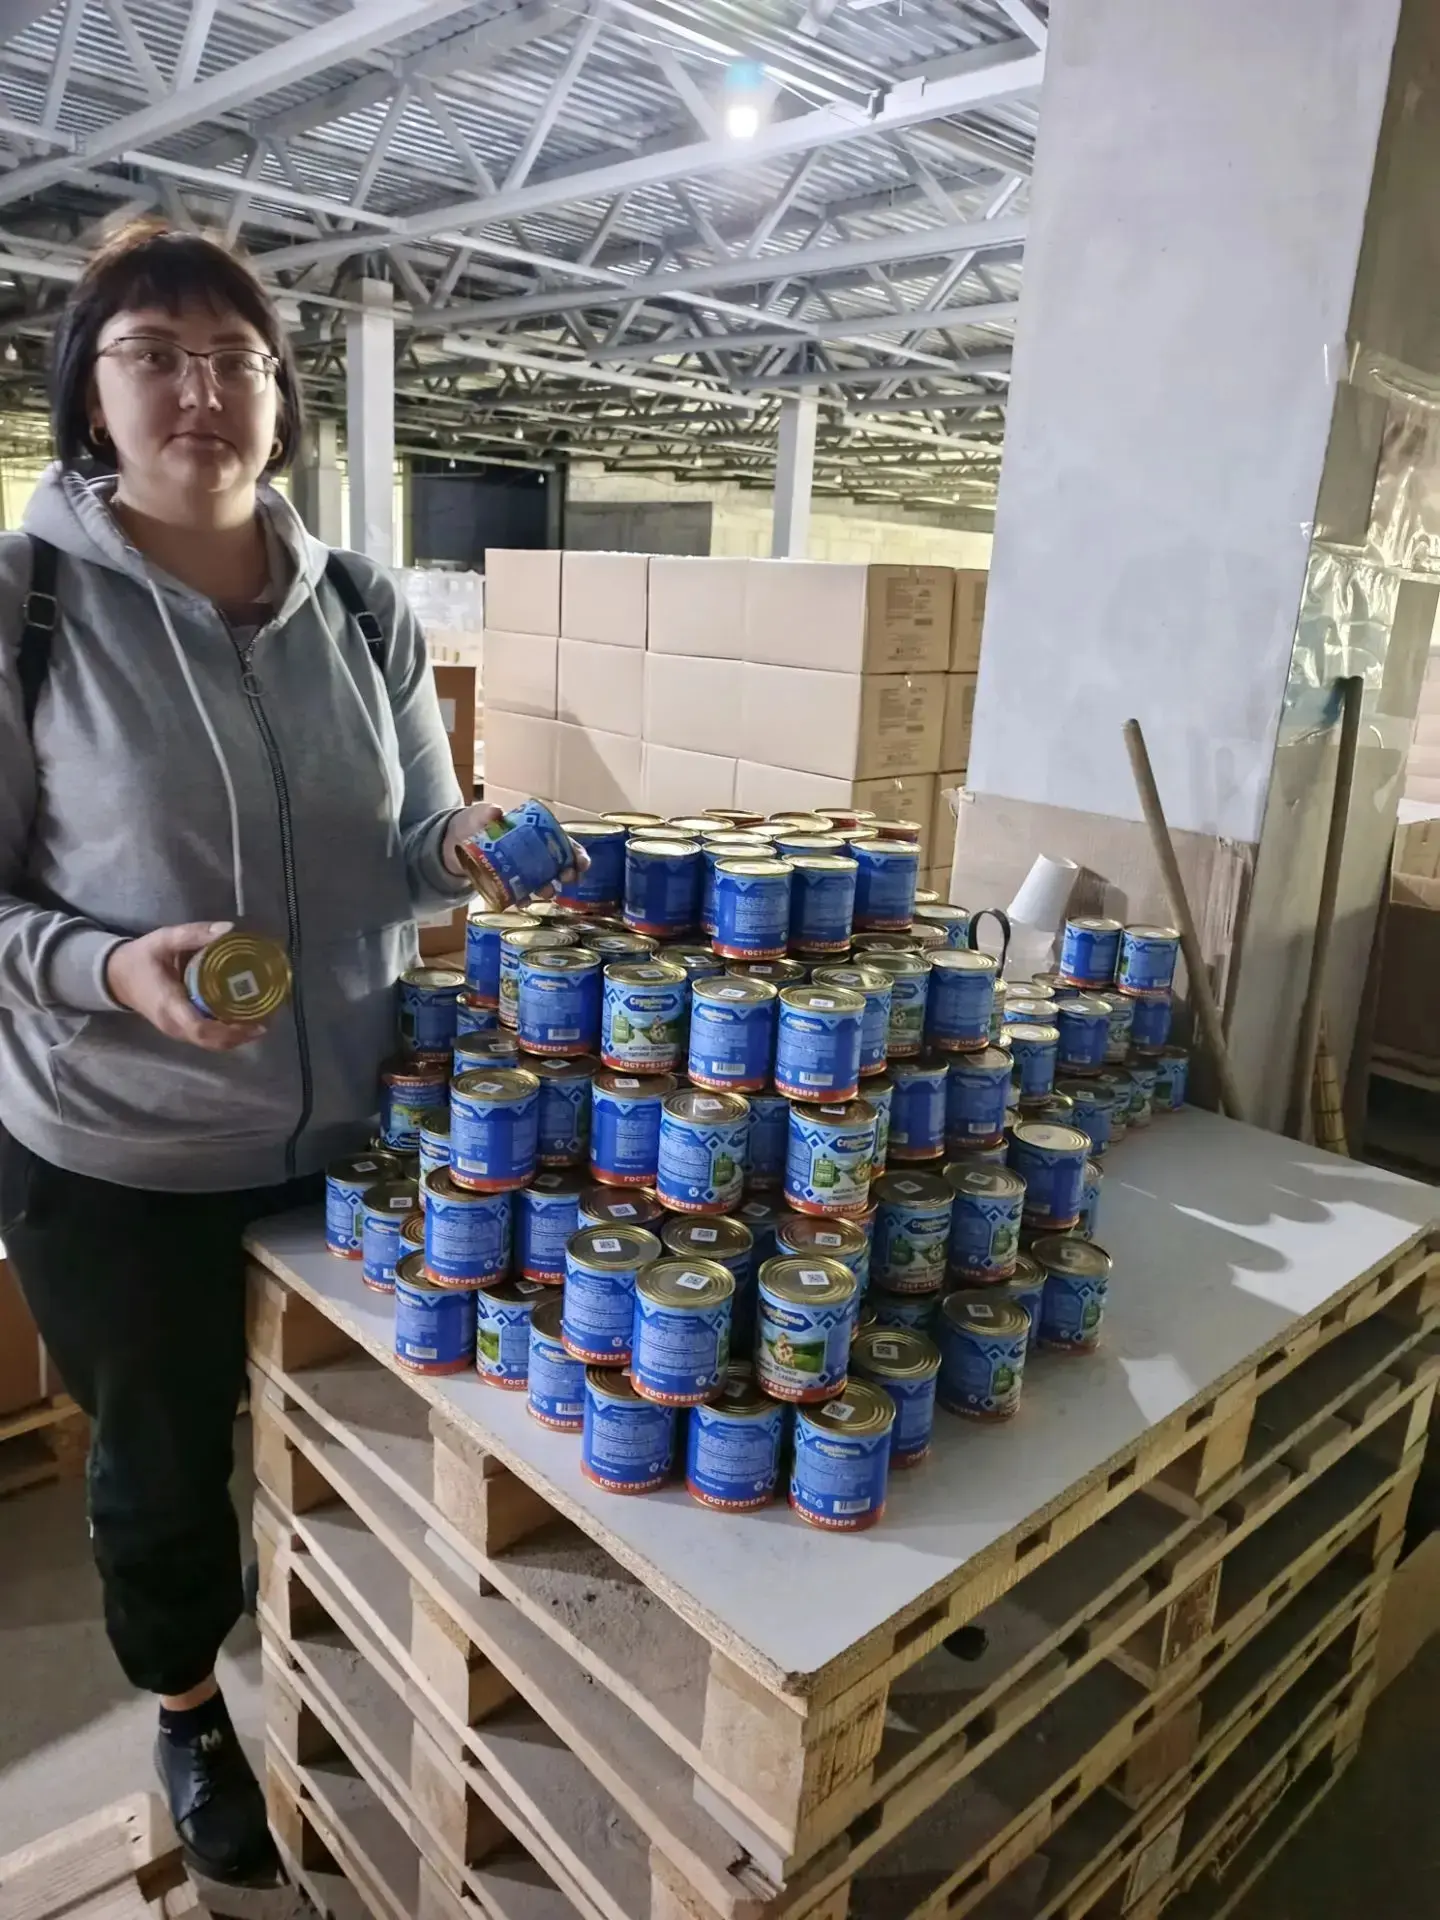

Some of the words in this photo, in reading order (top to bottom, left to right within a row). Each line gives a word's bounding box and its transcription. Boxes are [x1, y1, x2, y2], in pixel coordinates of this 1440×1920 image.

[539, 1271, 562, 1280] ГОСТ
[502, 1379, 526, 1387] ГОСТ
[644, 1387, 668, 1400] ГОСТ
[599, 1478, 622, 1489] ГОСТ
[703, 1494, 727, 1506] ГОСТ
